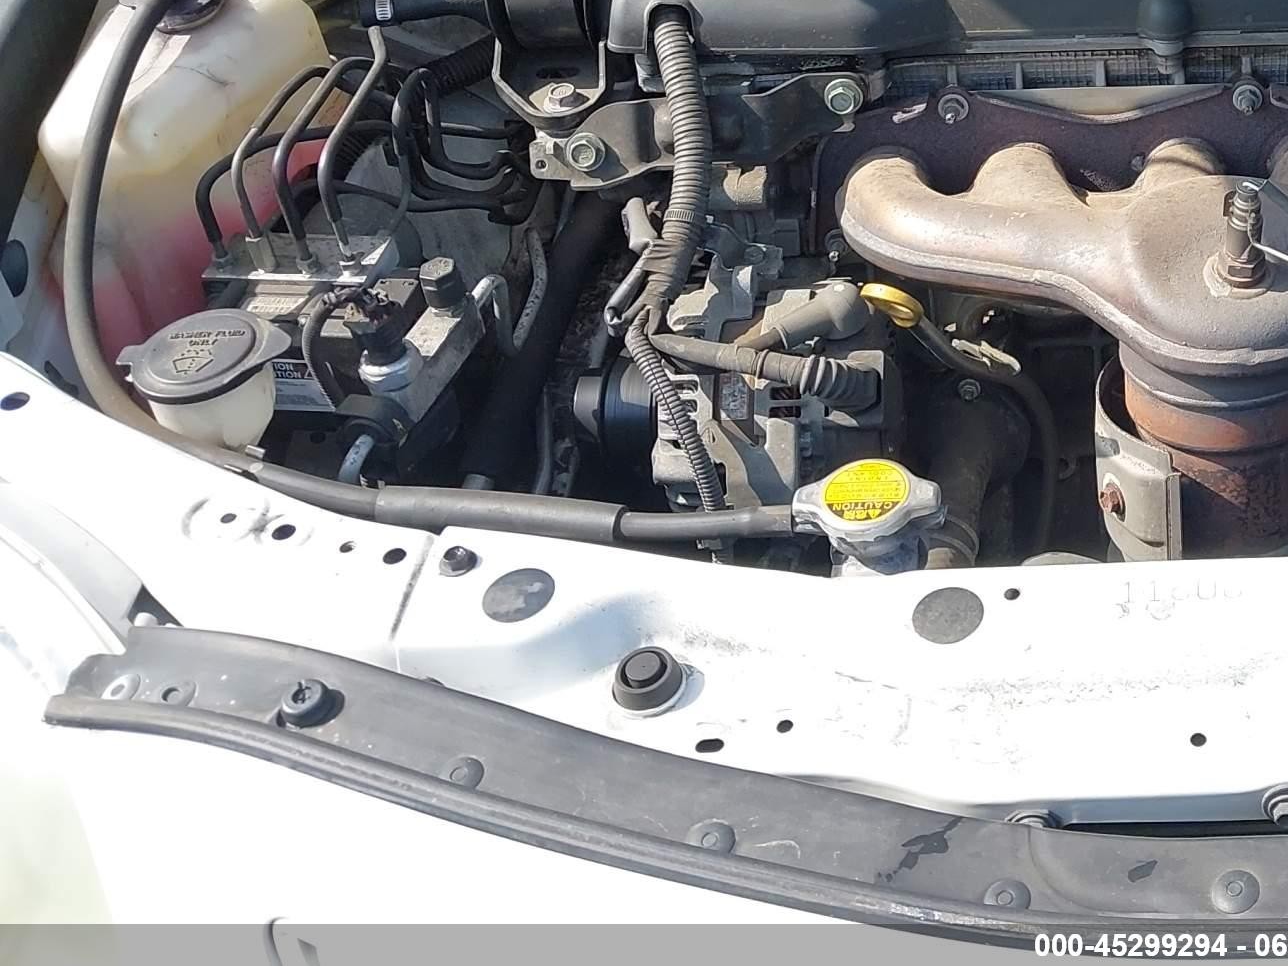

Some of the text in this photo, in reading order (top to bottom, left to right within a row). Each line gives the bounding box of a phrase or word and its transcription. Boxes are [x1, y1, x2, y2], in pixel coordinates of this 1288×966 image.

[274, 363, 294, 371] ION
[275, 371, 302, 379] TION
[832, 501, 894, 511] CAUTION
